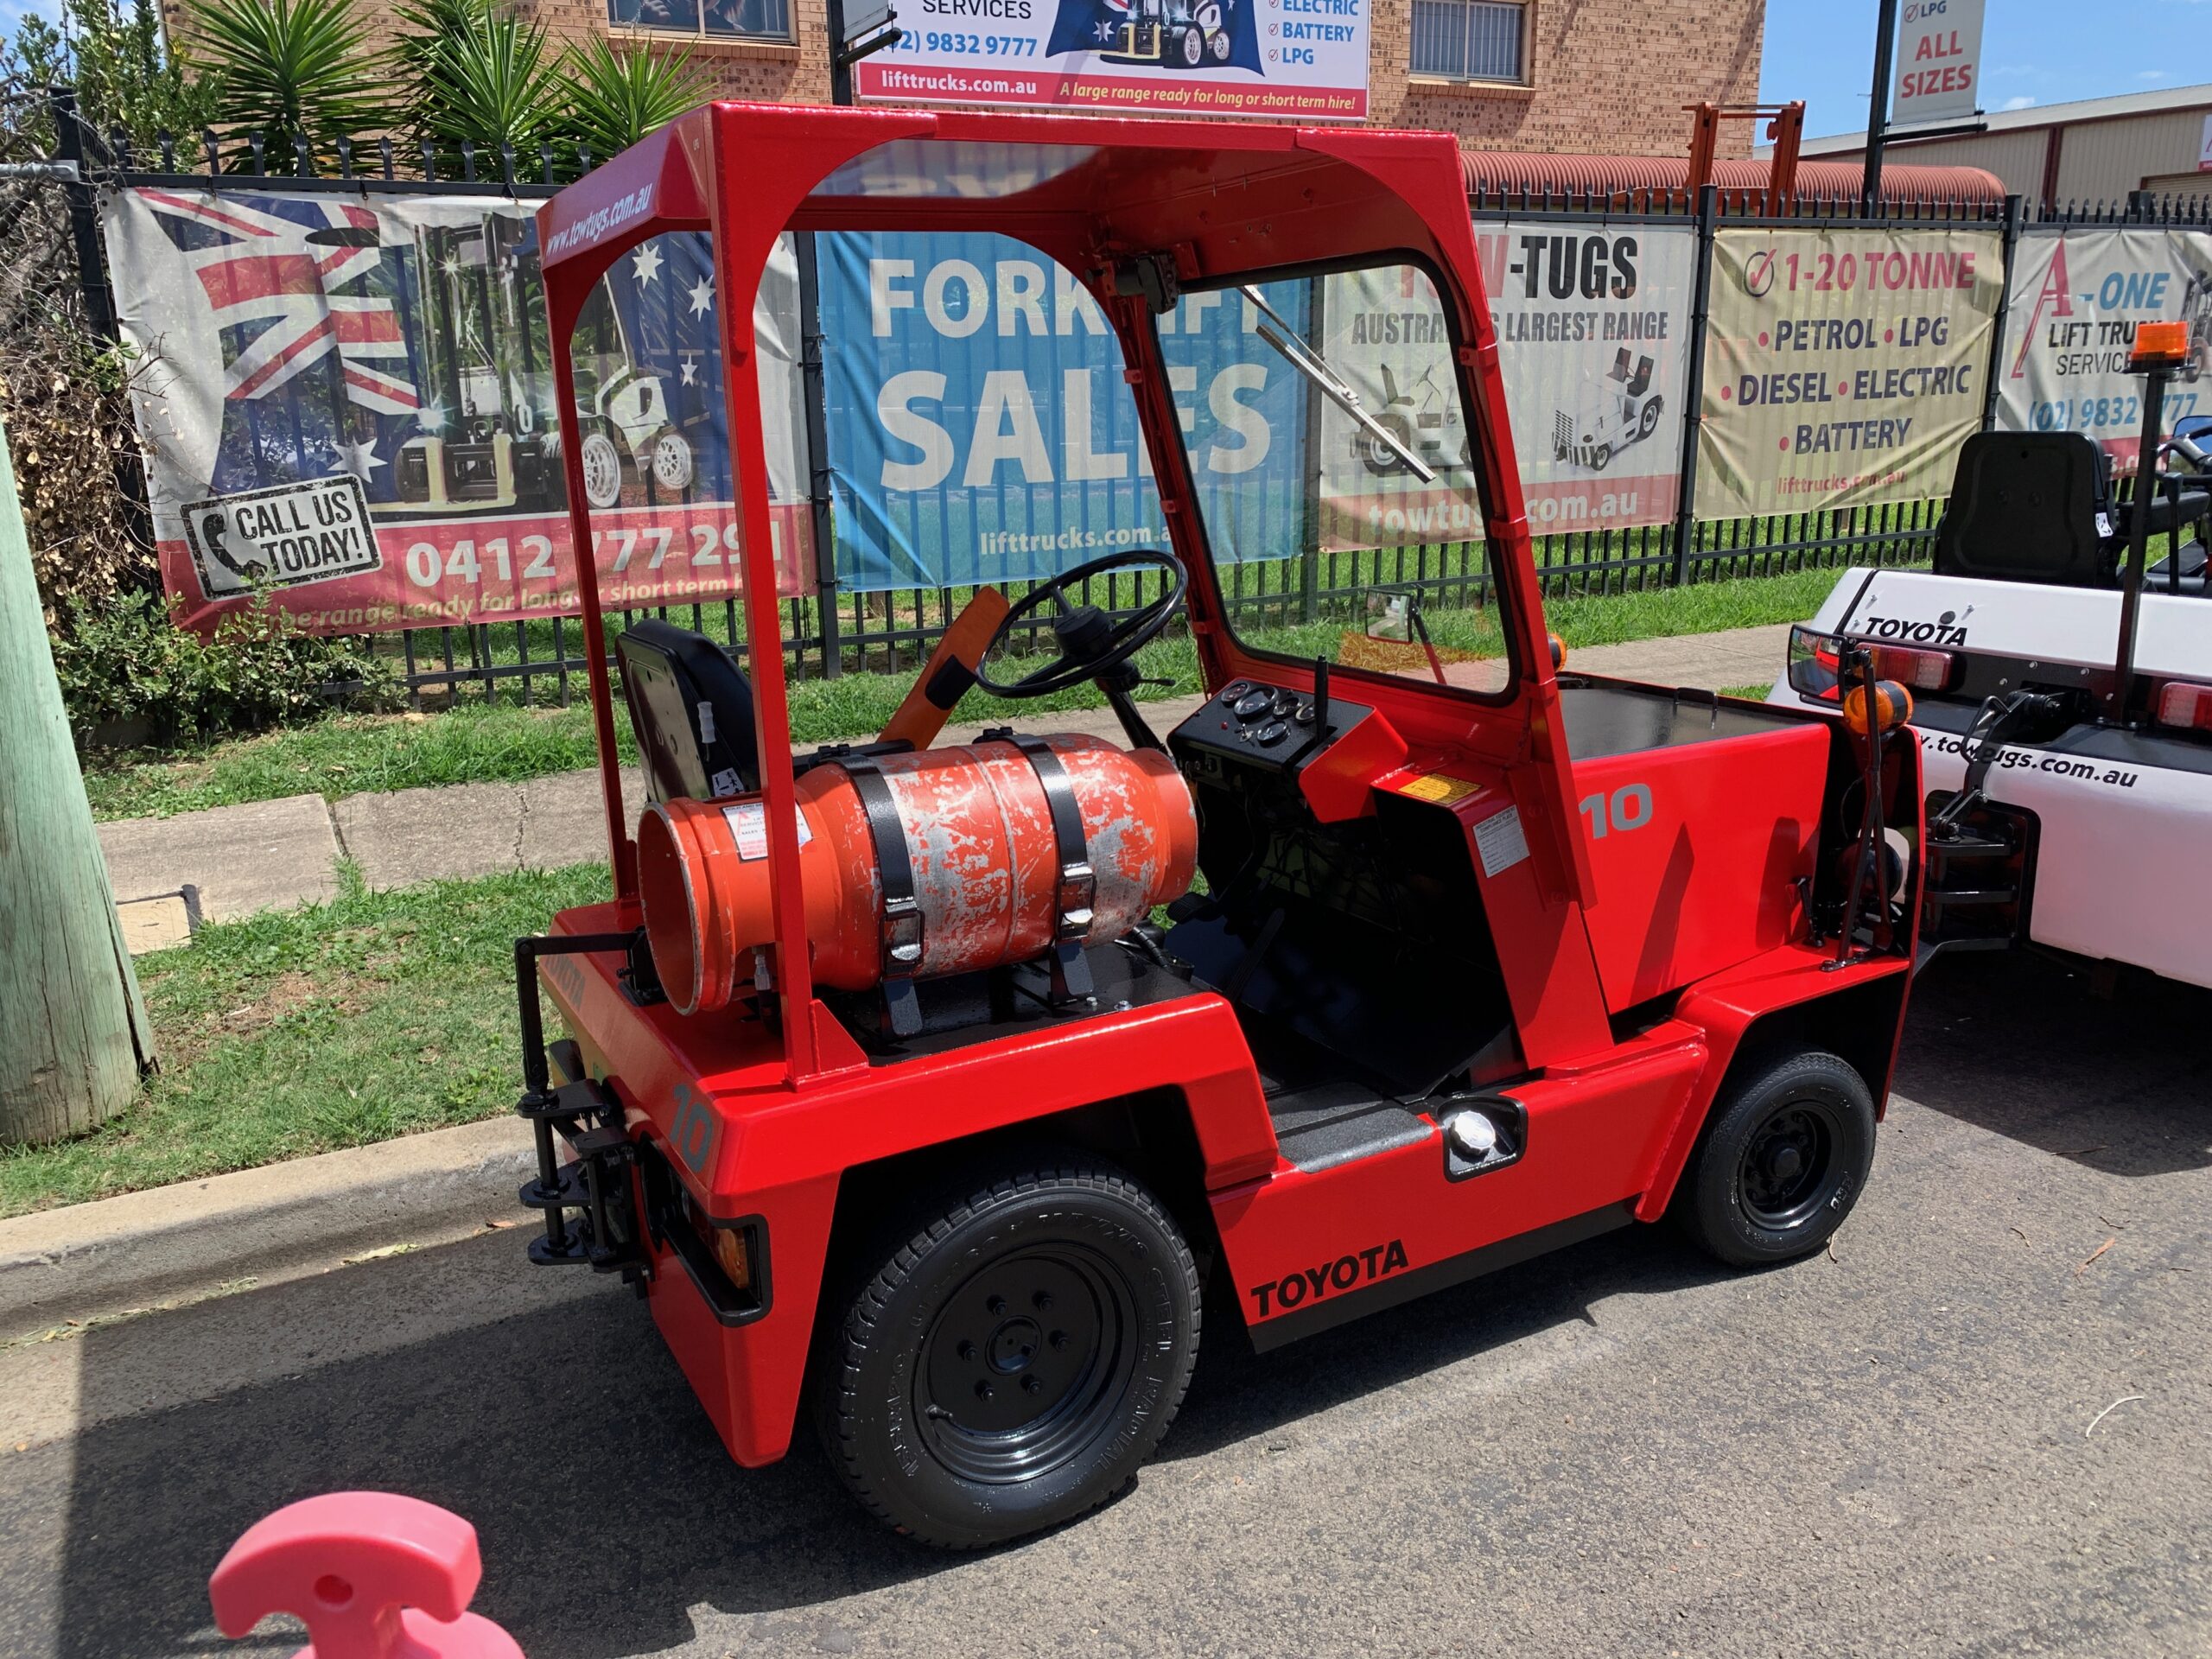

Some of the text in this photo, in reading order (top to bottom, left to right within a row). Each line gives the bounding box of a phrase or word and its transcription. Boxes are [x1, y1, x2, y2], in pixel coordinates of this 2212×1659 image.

[923, 0, 1032, 19] SERVICES
[1283, 0, 1358, 16] ELECTRIC
[1921, 1, 1947, 17] LPG
[926, 32, 980, 54] 9832
[986, 35, 1037, 57] 9777
[1282, 22, 1355, 41] BATTERY
[1916, 30, 1963, 61] ALL
[1282, 48, 1314, 65] LPG
[881, 70, 1037, 94] lifttrucks.com.au
[1060, 82, 1356, 109] A large range ready for long or short term hire!
[1902, 64, 1972, 99] SIZES
[546, 183, 652, 256] www.towtugs.com.au
[1785, 252, 1976, 291] 1-20 TONNE
[1505, 312, 1598, 341] LARGEST
[1602, 311, 1667, 340] RANGE
[1775, 316, 1948, 352] PETROL LPG
[2048, 322, 2093, 347] LIFT
[1738, 365, 1972, 406] DIESEL ELECTRIC
[2081, 396, 2138, 428] 9832
[1795, 417, 1913, 454] BATTERY
[235, 491, 353, 540] CALL US
[261, 527, 364, 575] TODAY!
[980, 525, 1172, 556] lifttrucks.com.a
[405, 534, 556, 587] 0412
[318, 602, 398, 628] range
[404, 594, 474, 620] ready
[480, 591, 515, 612] for
[521, 588, 574, 610] long
[610, 580, 671, 601] short
[676, 577, 728, 594] term
[1865, 617, 1967, 646] TOYOTA
[1579, 783, 1653, 839] 10
[669, 1083, 714, 1173] 10
[1251, 1238, 1408, 1318] TOYOTA
